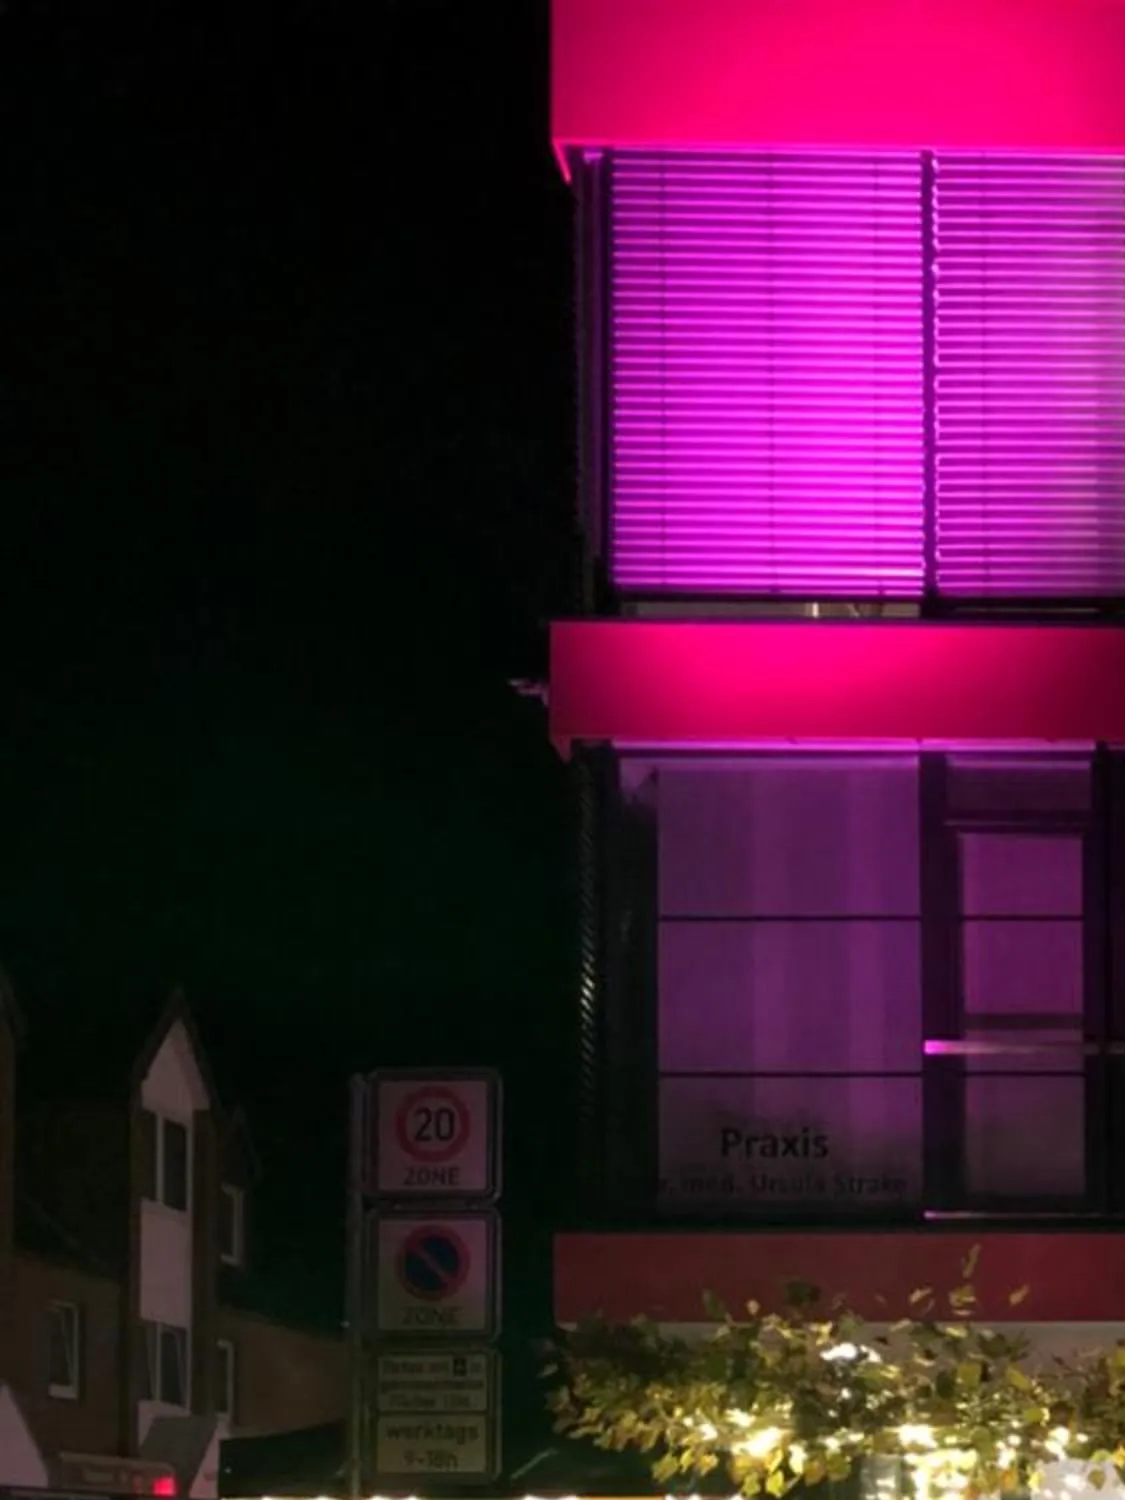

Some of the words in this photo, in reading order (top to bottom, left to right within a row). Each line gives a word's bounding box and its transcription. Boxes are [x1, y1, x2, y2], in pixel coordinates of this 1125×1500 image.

[414, 1107, 455, 1142] 20
[720, 1127, 829, 1158] Praxis
[403, 1166, 460, 1186] ZONE
[402, 1305, 461, 1325] ZONE
[386, 1422, 480, 1446] werktags
